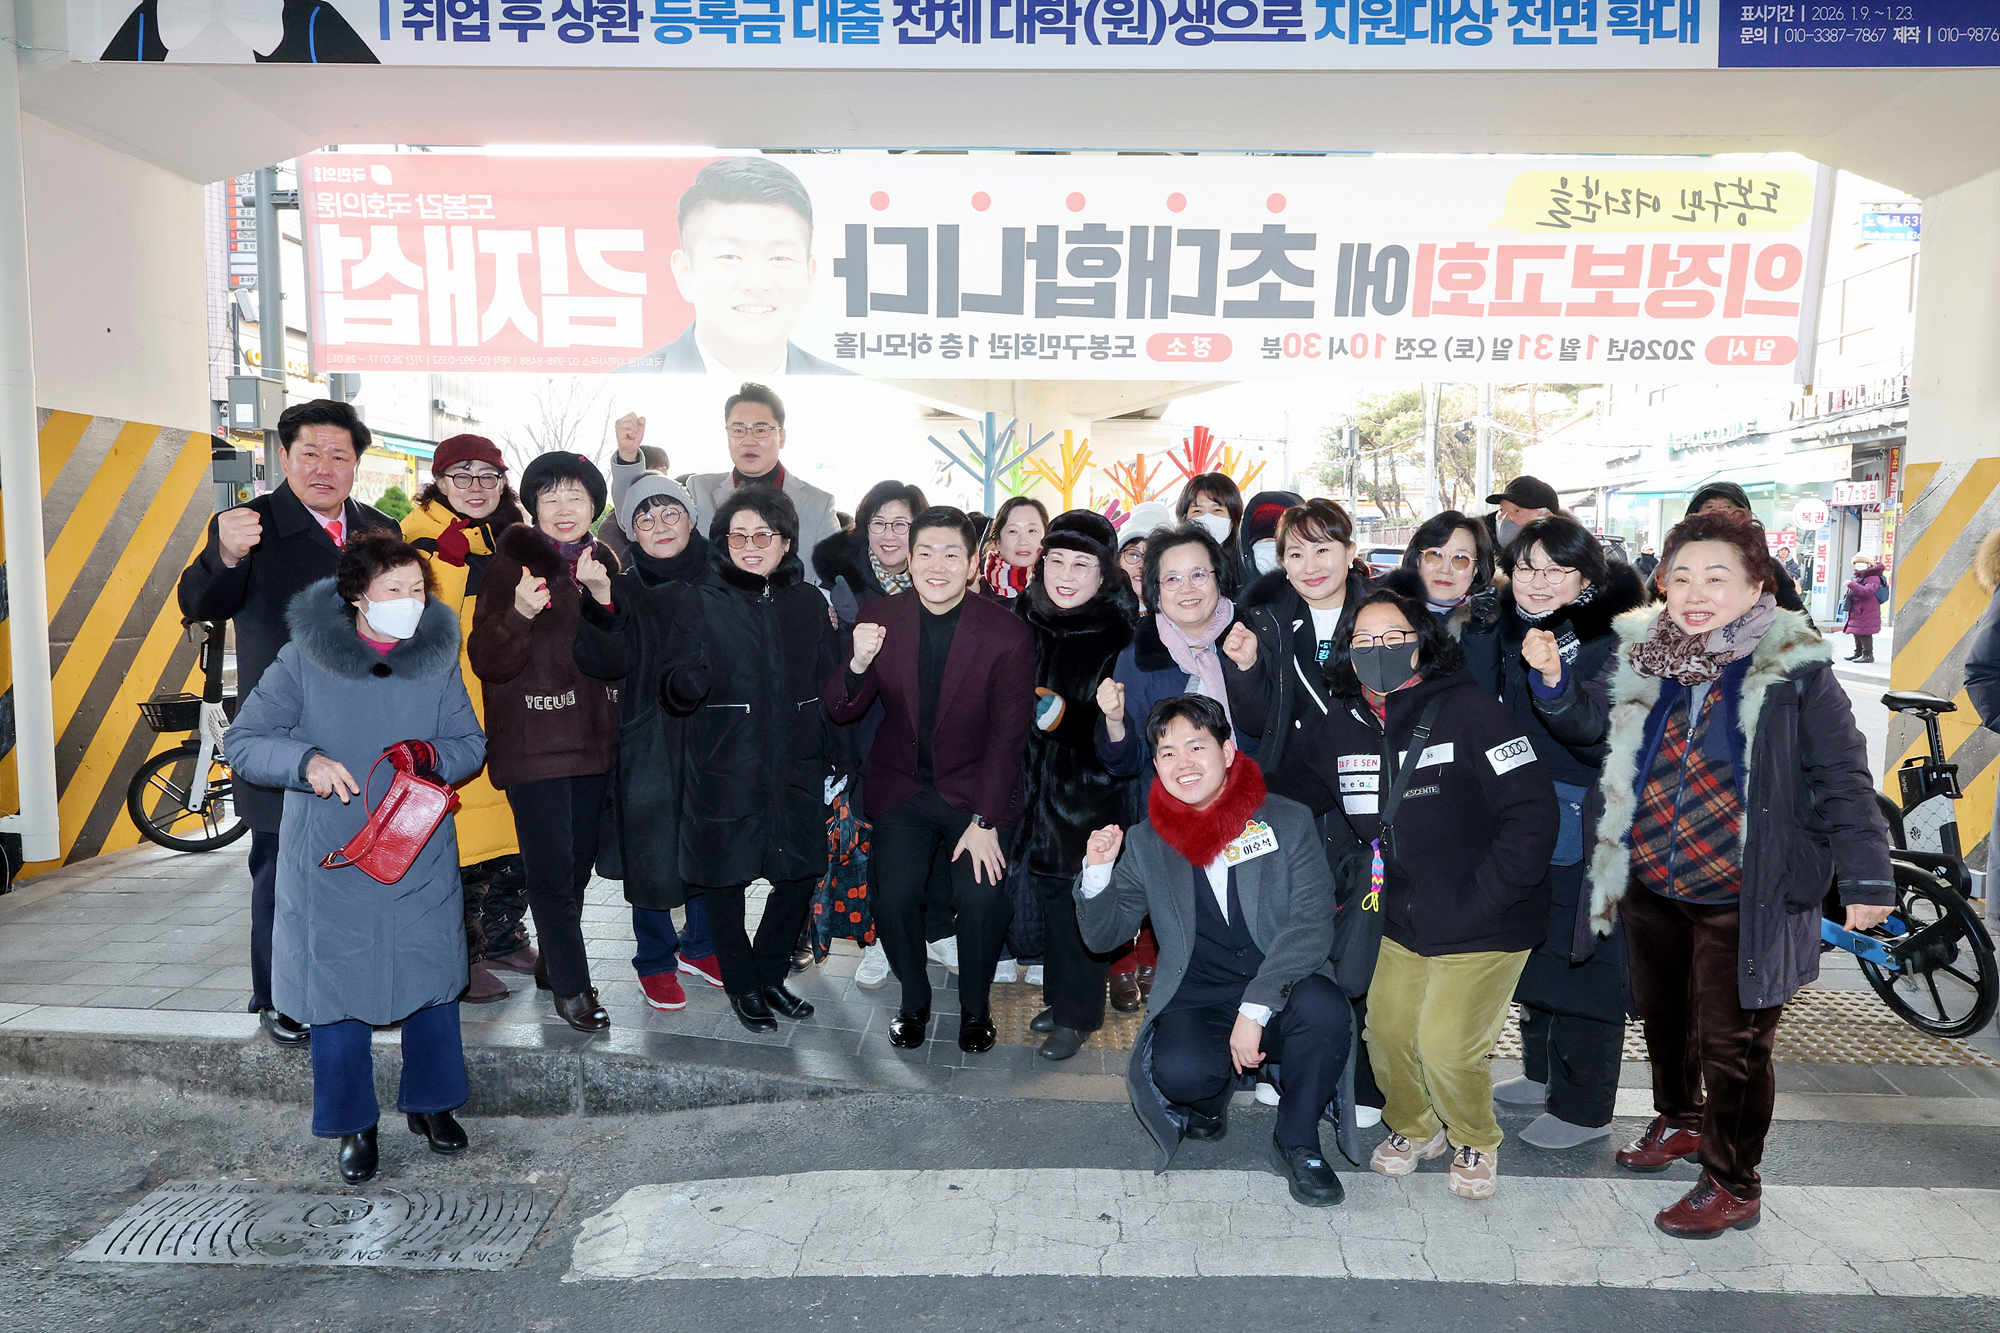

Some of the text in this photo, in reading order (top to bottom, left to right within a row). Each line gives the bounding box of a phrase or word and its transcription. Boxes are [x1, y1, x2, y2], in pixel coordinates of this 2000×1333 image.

[402, 0, 1700, 46] 취업 후 상환 등록금 대출 전체 대학(원)생으로 지원대상 전면 확대
[1740, 5, 1795, 23] 표시기간
[1811, 6, 1846, 21] 2026.
[1740, 26, 1768, 44] 문의
[1784, 27, 1887, 43] 010-3387-7867
[1892, 26, 1921, 44] 제작
[1863, 214, 1921, 228] 노해로63
[1802, 511, 1825, 524] 복권
[1765, 533, 1795, 547] 로또
[1816, 544, 1827, 583] 복권
[1243, 837, 1272, 855] 이호석
